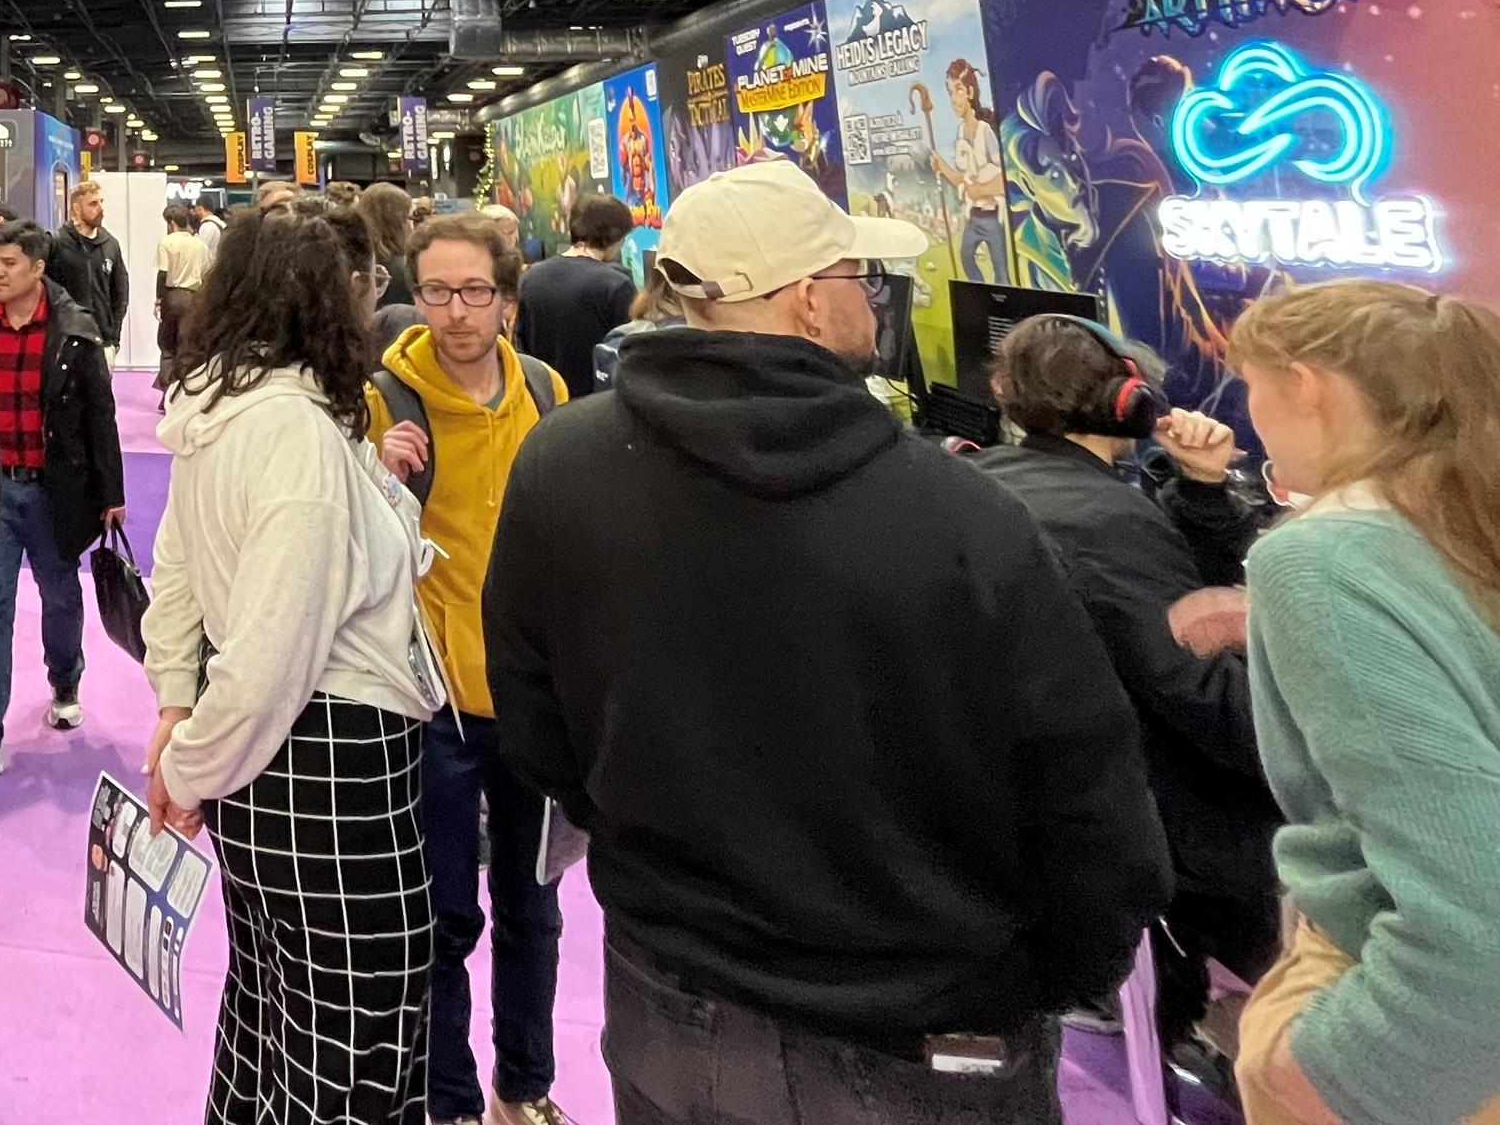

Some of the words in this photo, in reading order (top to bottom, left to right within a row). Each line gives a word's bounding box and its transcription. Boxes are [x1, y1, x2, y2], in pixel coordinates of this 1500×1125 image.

[835, 36, 875, 70] HEIDI'S
[877, 19, 928, 59] LEGACY
[737, 65, 785, 91] PLANET
[792, 53, 829, 78] MINE
[237, 134, 245, 174] COSPLAY
[263, 106, 275, 160] GAMING
[307, 134, 315, 175] COSPLAY
[415, 105, 428, 160] GAMING
[1158, 196, 1438, 269] SKYTALE
